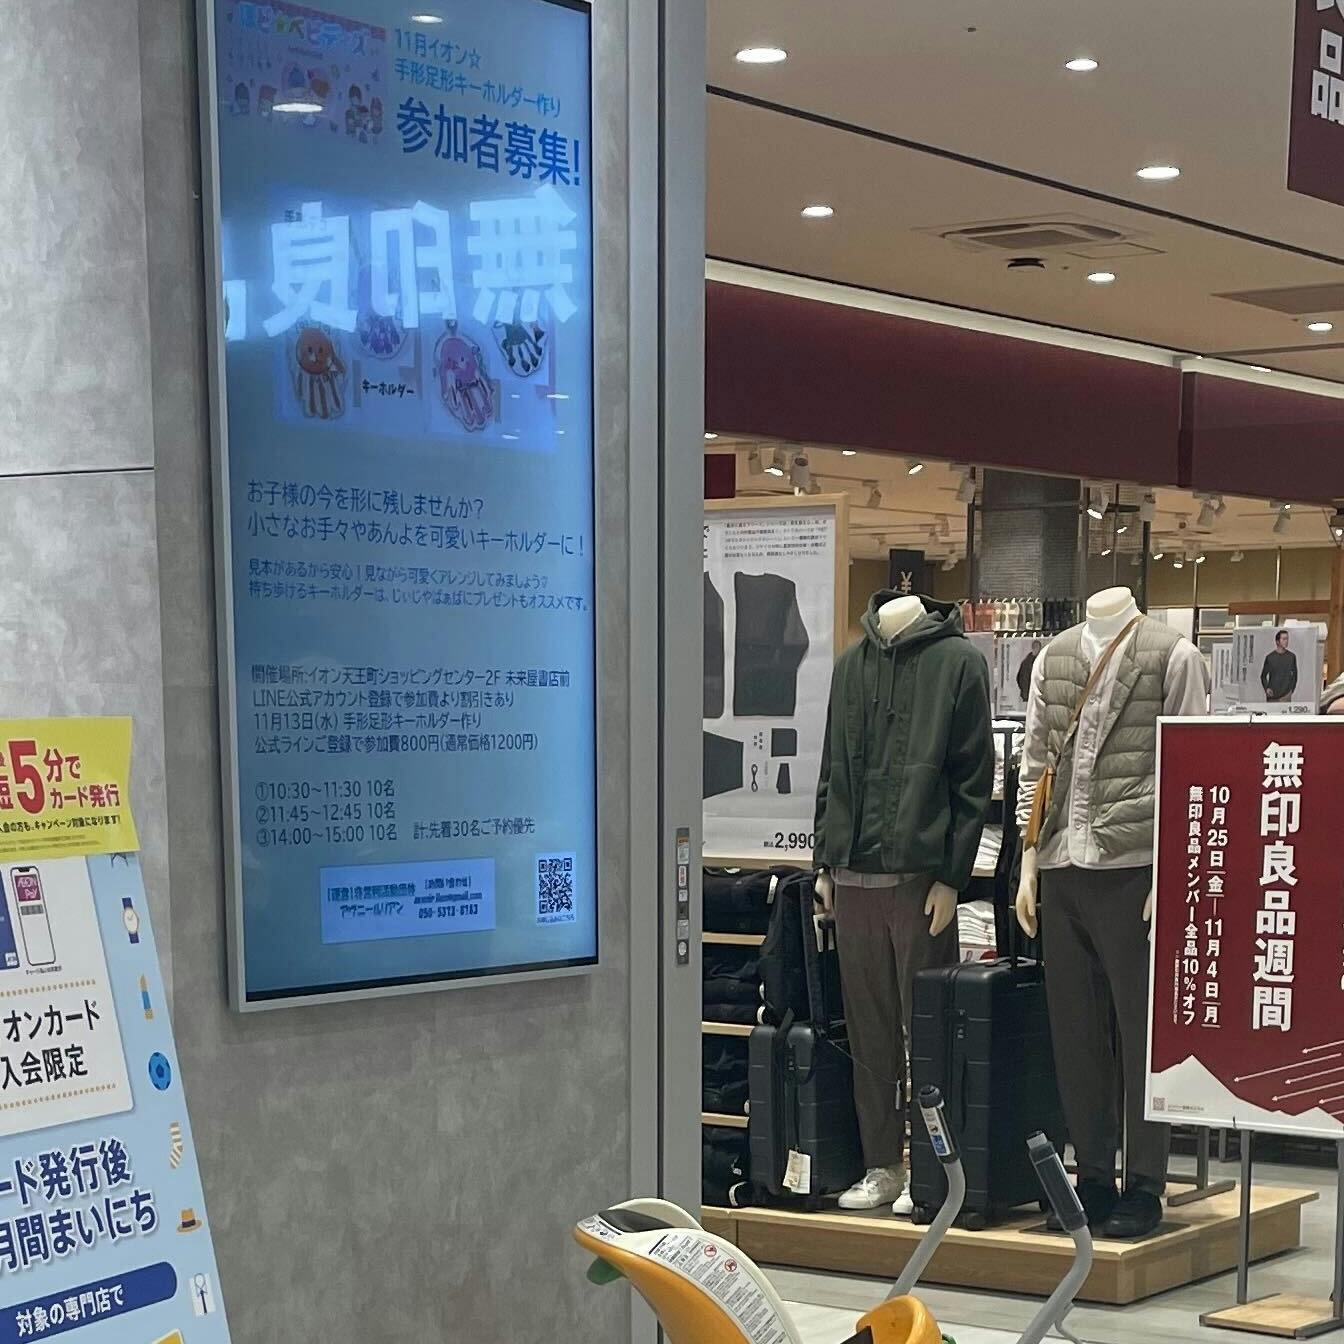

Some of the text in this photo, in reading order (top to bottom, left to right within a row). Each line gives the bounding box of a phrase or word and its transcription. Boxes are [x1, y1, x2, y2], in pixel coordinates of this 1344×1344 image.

[394, 58, 561, 117] 手形足形キーホルダー作り
[396, 97, 580, 185] 参加者募集!
[248, 479, 484, 520] お子様の今を形に残しませんか?
[248, 513, 584, 556] 小さなお手々やあんよを可愛いキーホルダーに!
[343, 712, 482, 730] 手形足形キーホルダー作り
[50, 784, 120, 810] カード発行
[367, 780, 395, 797] 10名
[367, 802, 396, 819] 10名
[370, 823, 397, 841] 10名
[1182, 785, 1204, 1026] 無印良品メンバー全品10%オフ
[1252, 741, 1305, 1033] 無印良品週間
[16, 1284, 124, 1338] 対象の専門店で
